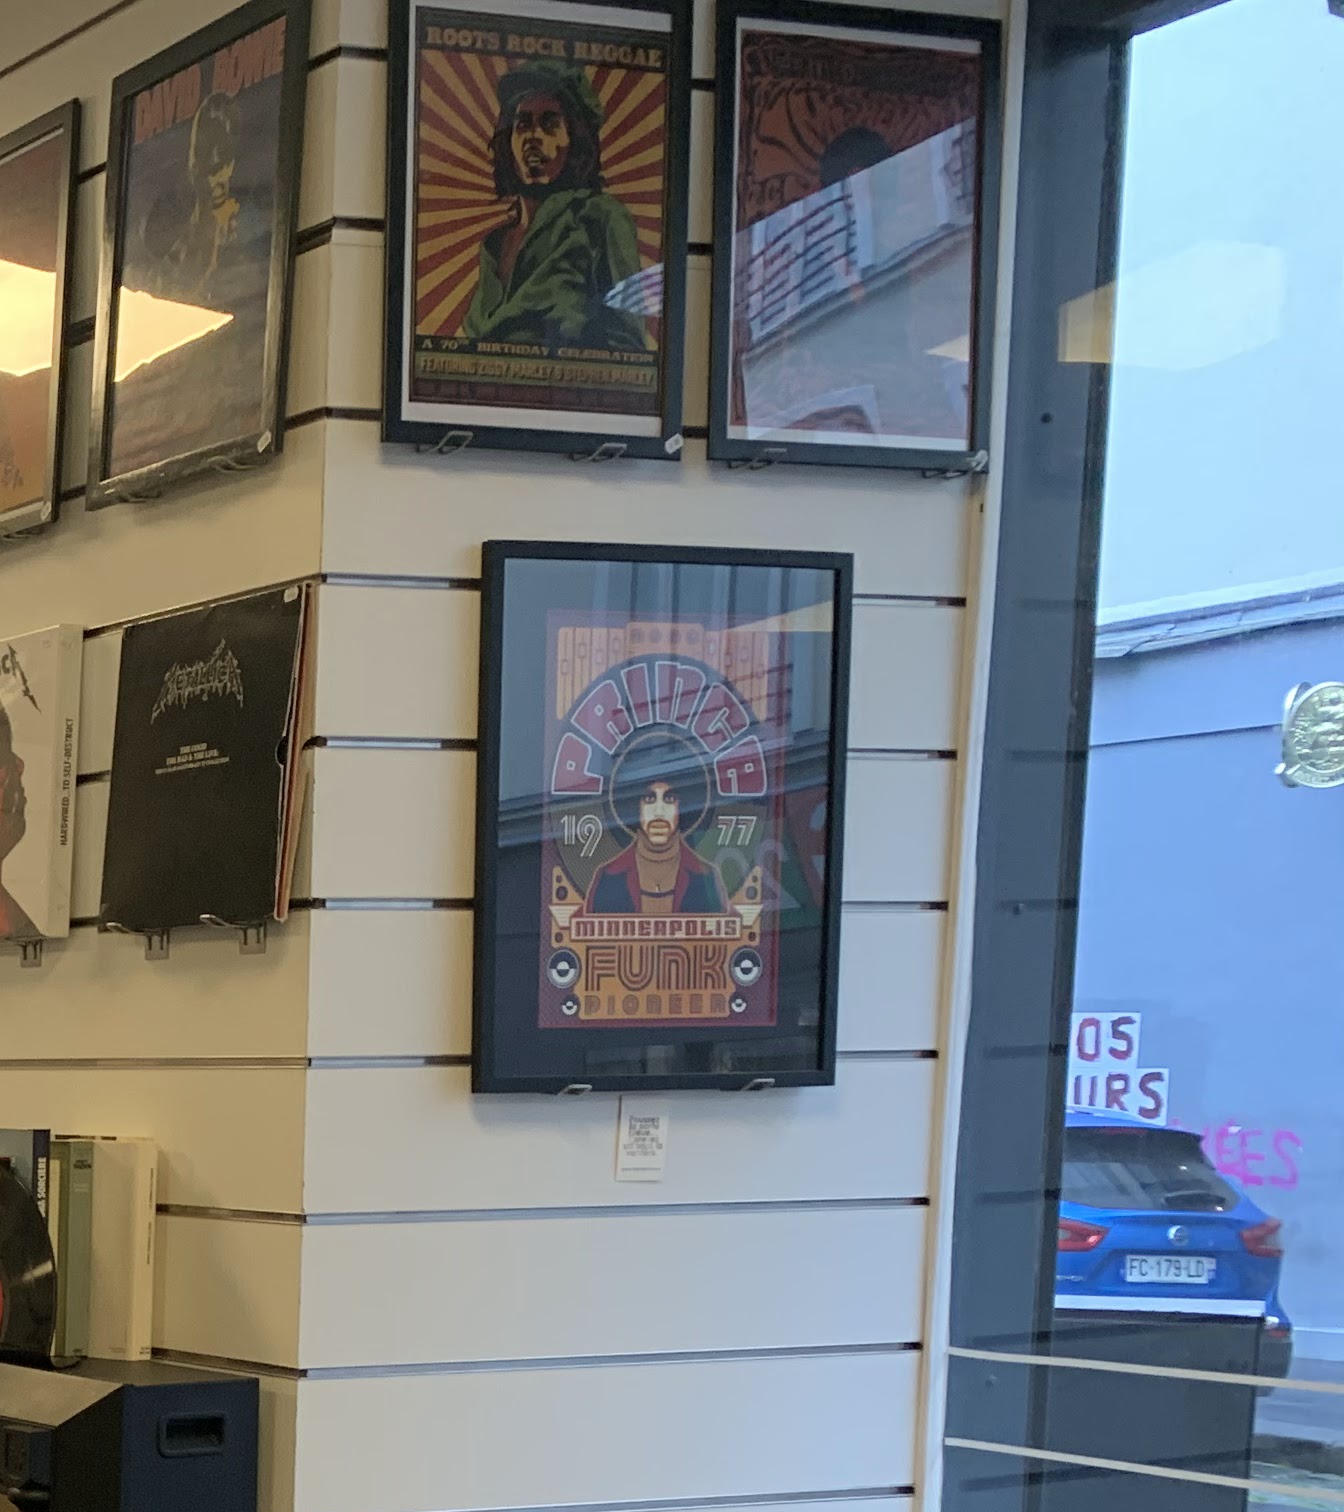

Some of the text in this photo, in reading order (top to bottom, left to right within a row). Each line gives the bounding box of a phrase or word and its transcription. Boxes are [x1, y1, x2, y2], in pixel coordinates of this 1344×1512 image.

[427, 27, 662, 67] ROOTS ROCK REGGAE
[134, 15, 286, 144] DAVID BOWIE
[422, 338, 433, 350] A
[477, 342, 549, 356] BIRTHDAY
[551, 660, 768, 797] PRINCE
[561, 814, 758, 858] 19 77
[575, 920, 738, 938] MINNEAPOLIS
[584, 944, 728, 992] FUNK
[584, 994, 727, 1016] PIONEER
[1128, 1257, 1206, 1279] FC-179-LD
